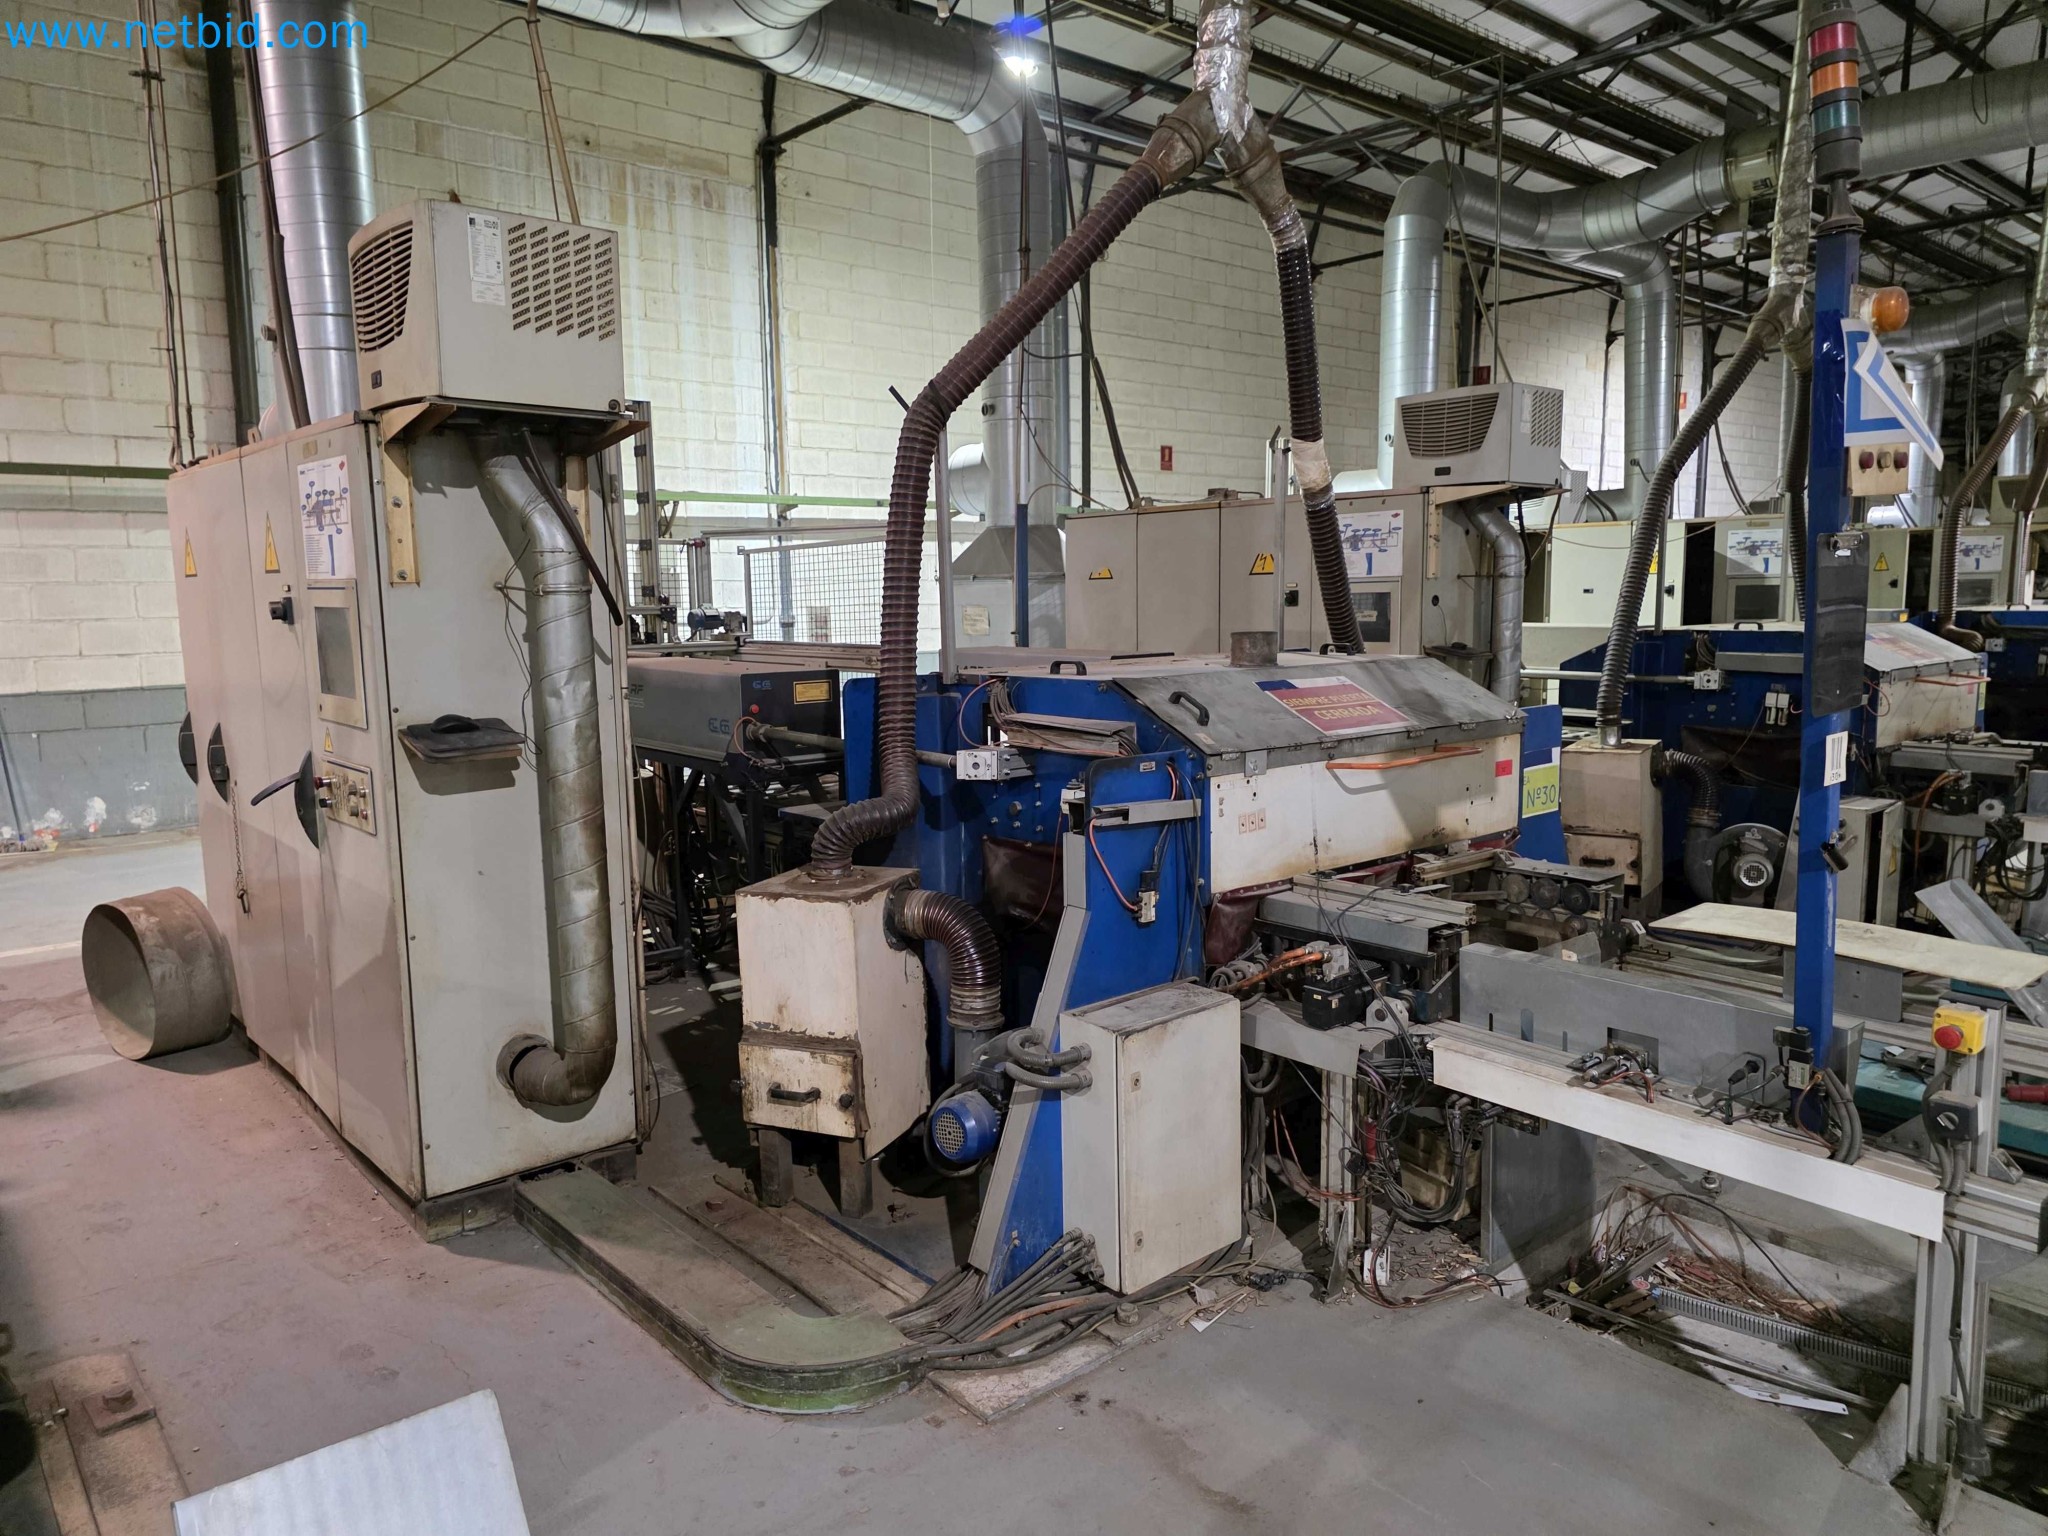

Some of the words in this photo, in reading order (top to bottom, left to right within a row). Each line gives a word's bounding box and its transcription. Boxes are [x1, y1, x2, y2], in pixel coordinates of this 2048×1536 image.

[1283, 696, 1330, 707] SIEMPRE
[1330, 692, 1373, 704] PUERTA
[1314, 705, 1384, 720] CERRADA
